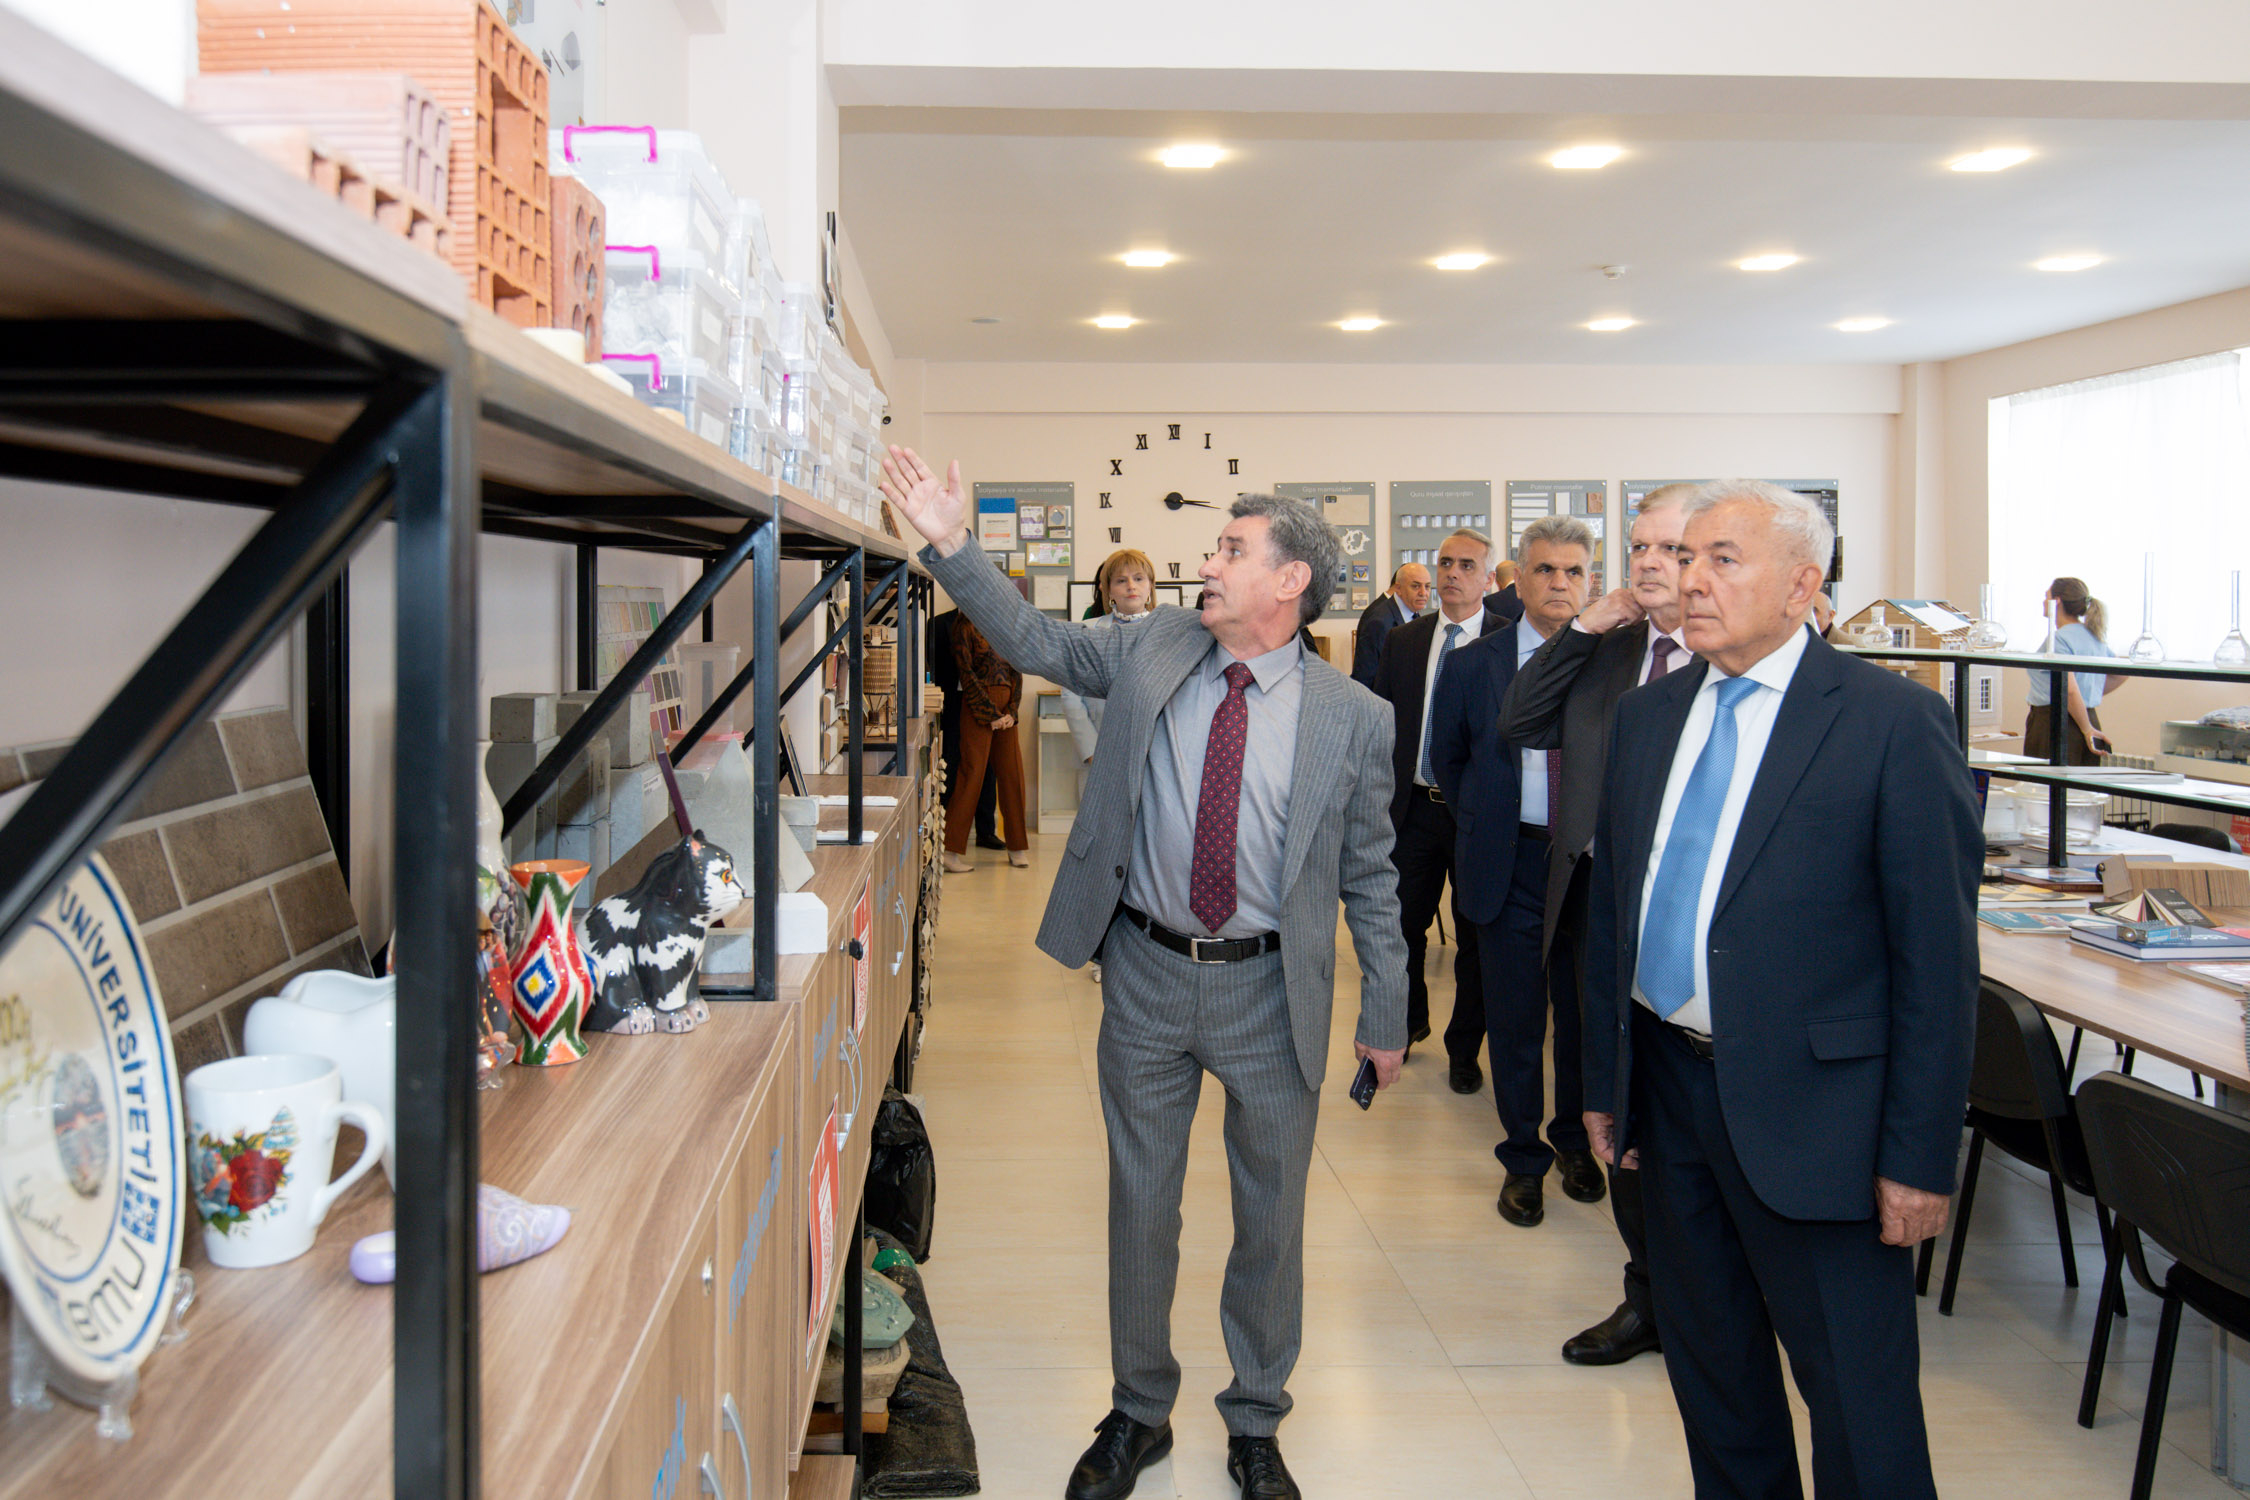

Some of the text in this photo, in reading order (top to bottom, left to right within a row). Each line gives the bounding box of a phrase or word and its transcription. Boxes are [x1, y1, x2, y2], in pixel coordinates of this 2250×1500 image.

[1168, 424, 1181, 440] XII
[1136, 434, 1149, 450] XI
[1204, 433, 1211, 449] I
[1110, 459, 1123, 476] X
[1228, 459, 1239, 475] II
[1099, 492, 1112, 509] IX
[1108, 527, 1121, 543] VIII
[1168, 562, 1180, 578] VI
